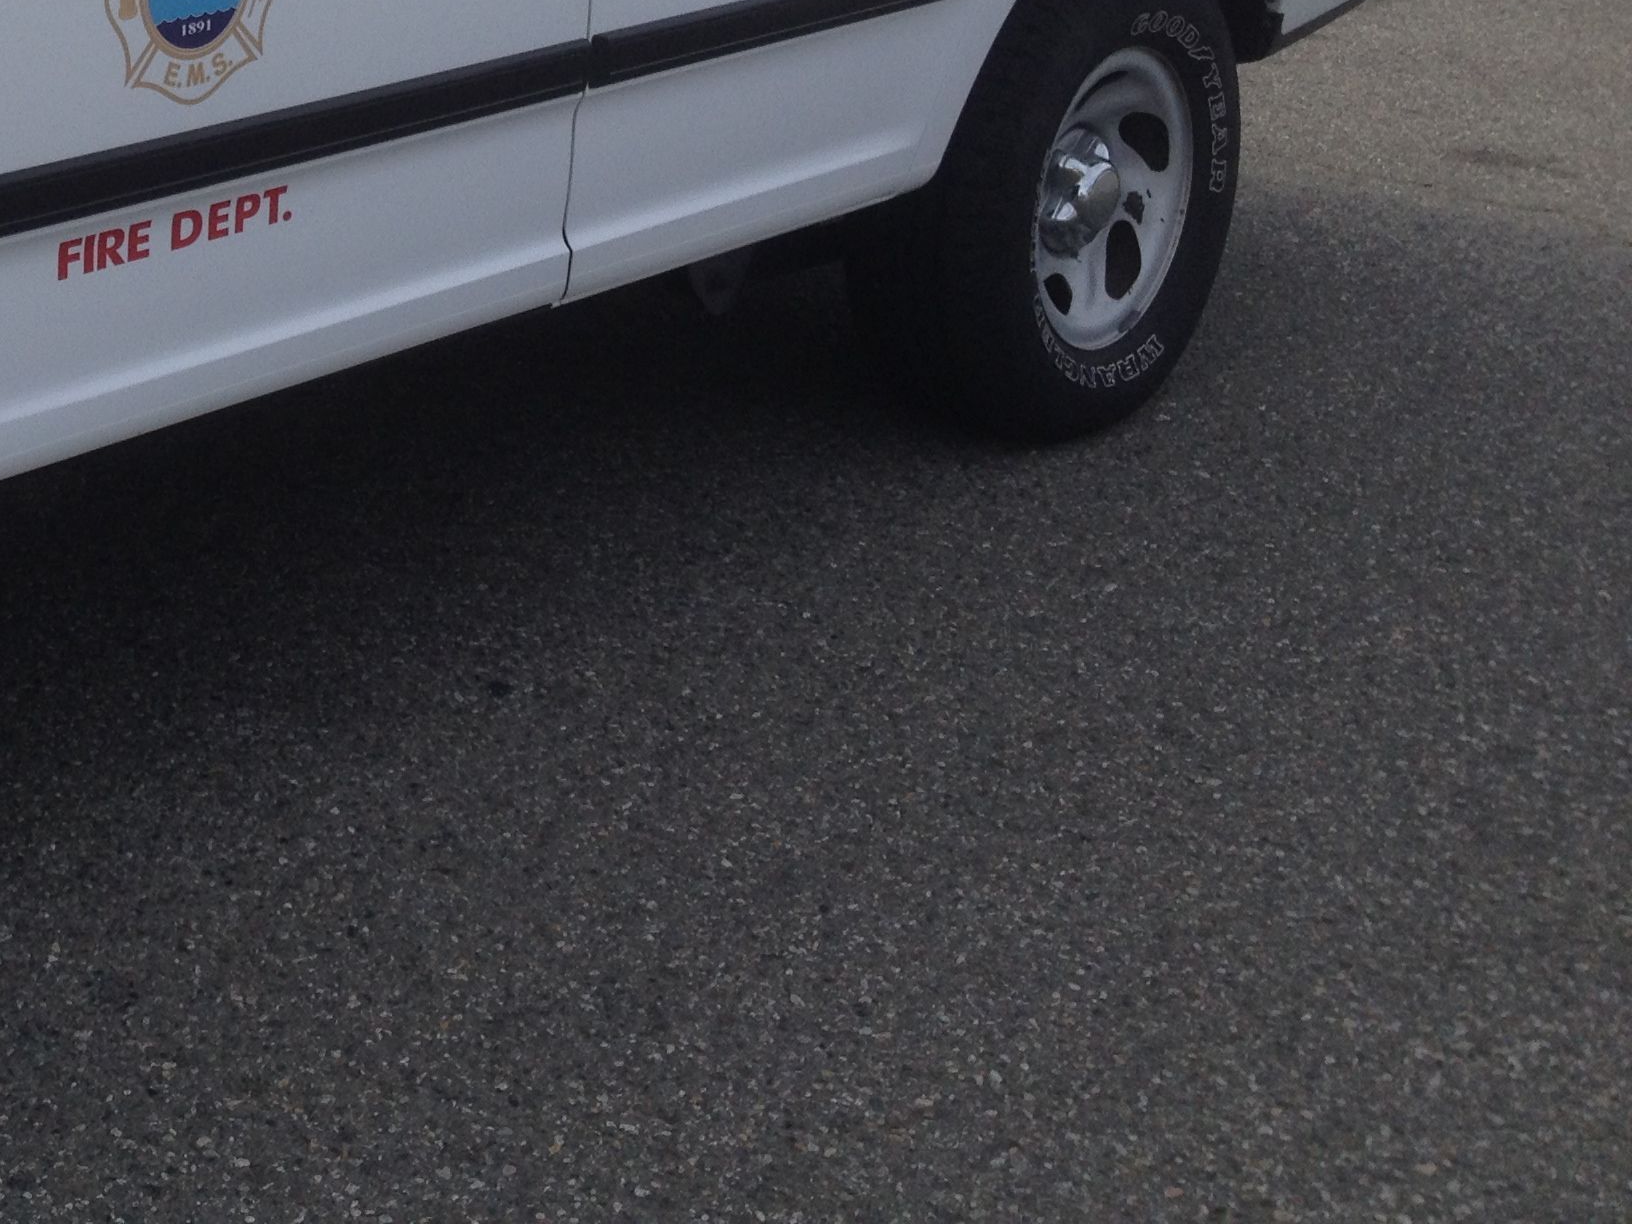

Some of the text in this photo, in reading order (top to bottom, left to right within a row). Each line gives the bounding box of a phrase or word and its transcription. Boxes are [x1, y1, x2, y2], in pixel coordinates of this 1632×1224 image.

[181, 19, 212, 37] 1891
[163, 51, 234, 89] E.M.S.
[1130, 10, 1228, 194] GOODYEAR
[57, 184, 293, 281] FIRE DEPT.
